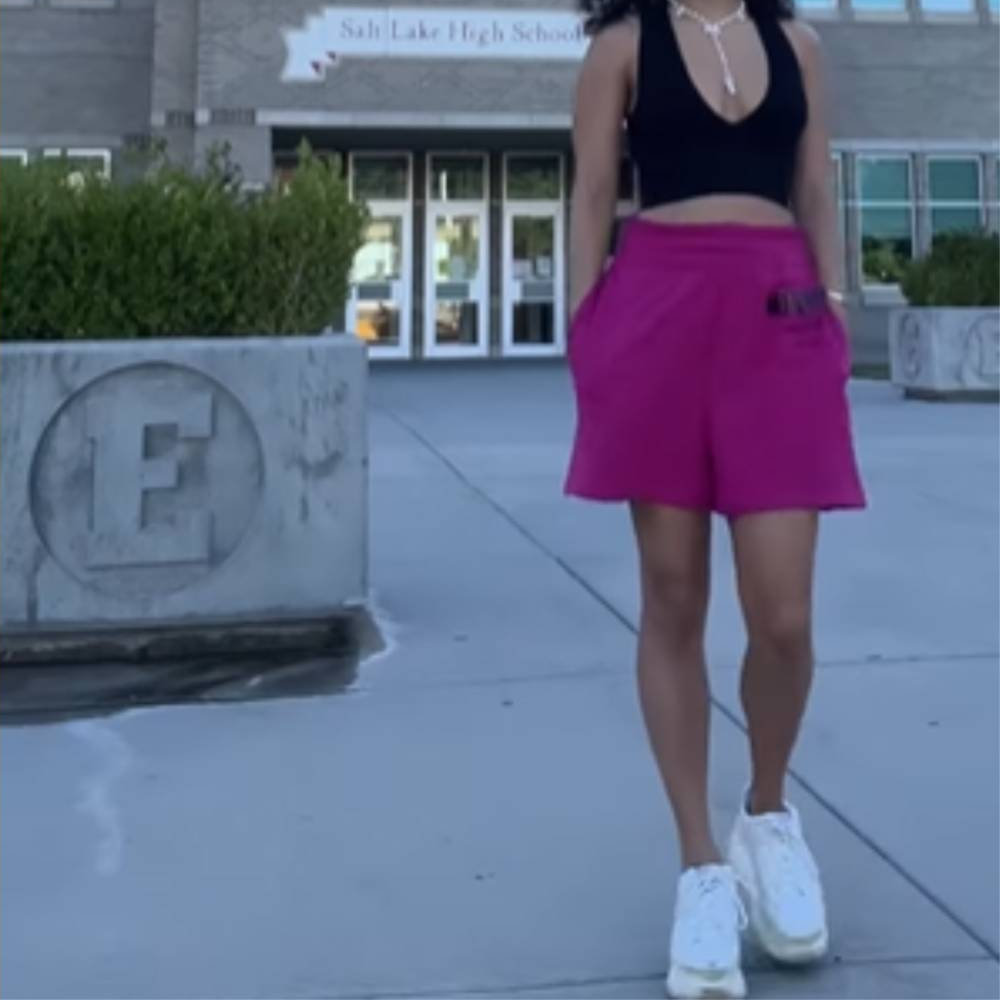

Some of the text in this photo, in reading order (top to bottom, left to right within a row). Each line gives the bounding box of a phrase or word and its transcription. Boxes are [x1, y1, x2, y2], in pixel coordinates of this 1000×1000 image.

[391, 18, 440, 41] Lake
[449, 20, 504, 47] High
[511, 22, 585, 44] School
[85, 392, 214, 571] E
